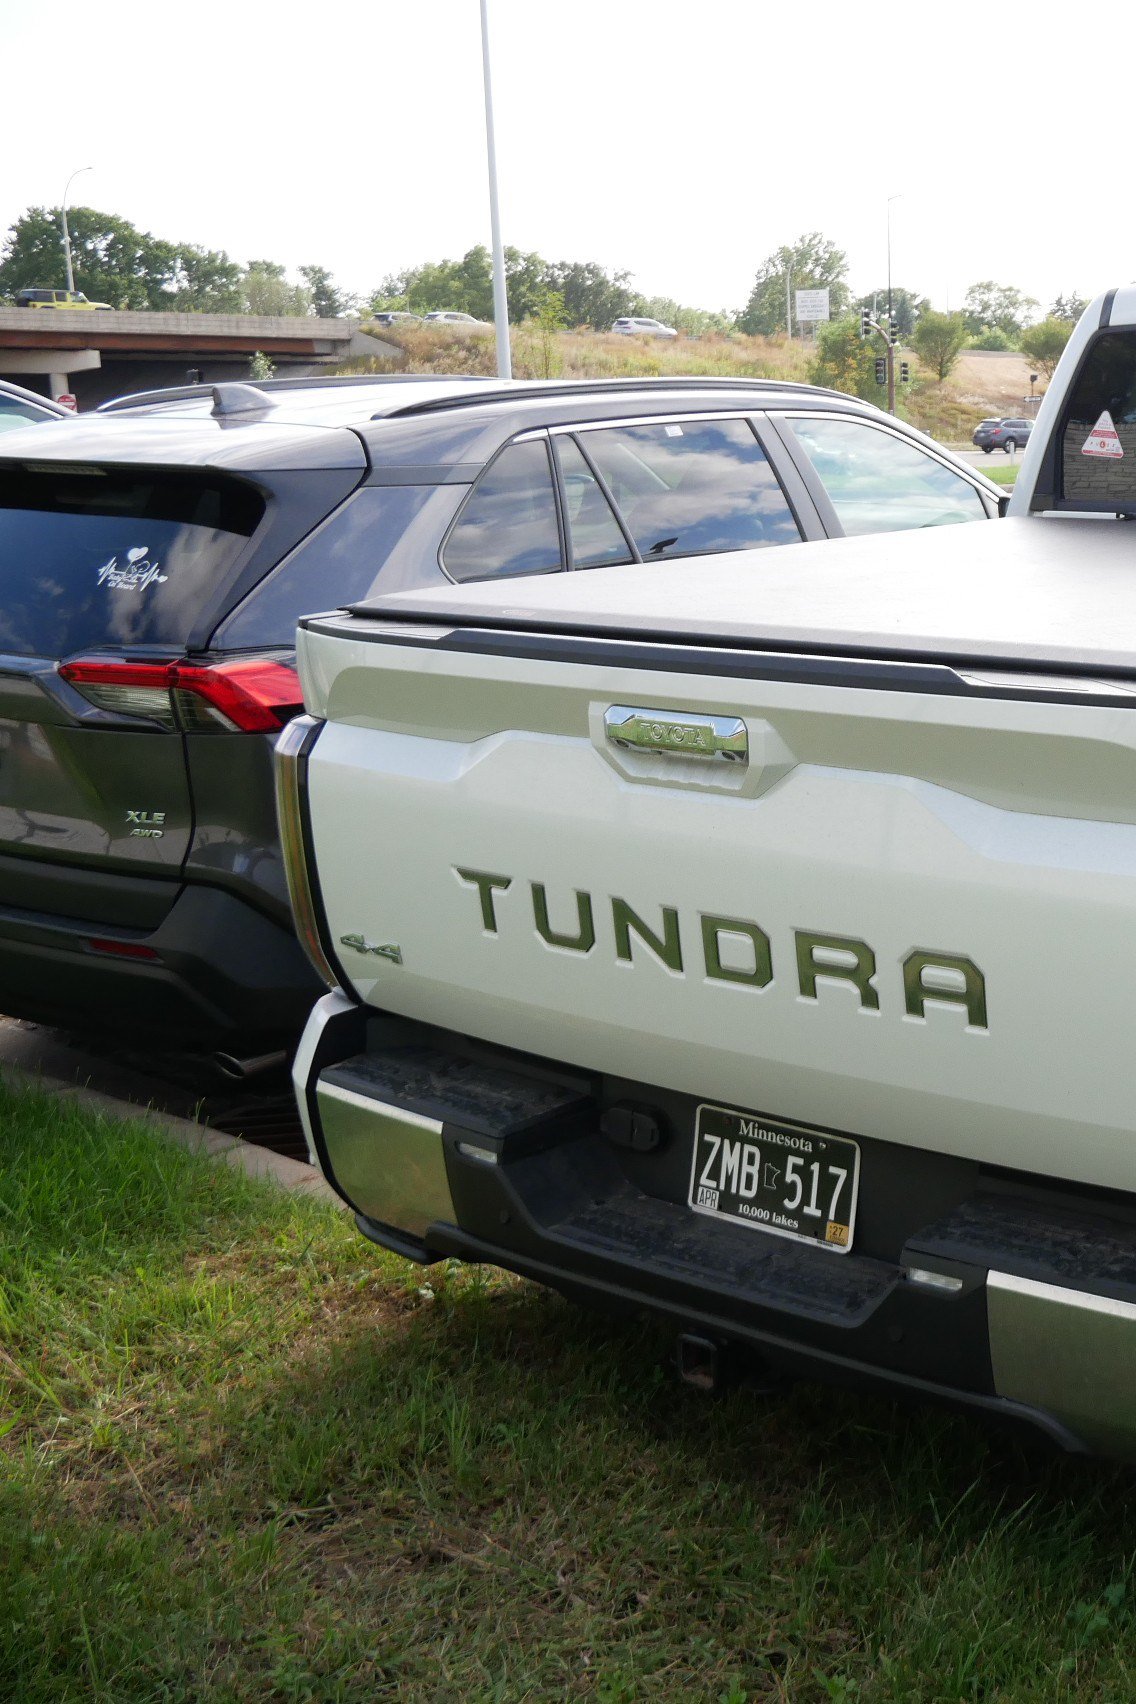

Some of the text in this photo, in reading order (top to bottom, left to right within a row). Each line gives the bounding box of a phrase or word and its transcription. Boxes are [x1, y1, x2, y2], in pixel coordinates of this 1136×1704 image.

[640, 722, 706, 747] TOYOTA
[125, 810, 166, 824] XLE
[129, 828, 164, 838] AWD
[451, 863, 991, 1035] TUNDRA
[738, 1119, 813, 1153] Minnesota
[699, 1133, 849, 1221] ZMB 517
[698, 1187, 718, 1209] APR
[737, 1203, 799, 1229] 10,000 lakes
